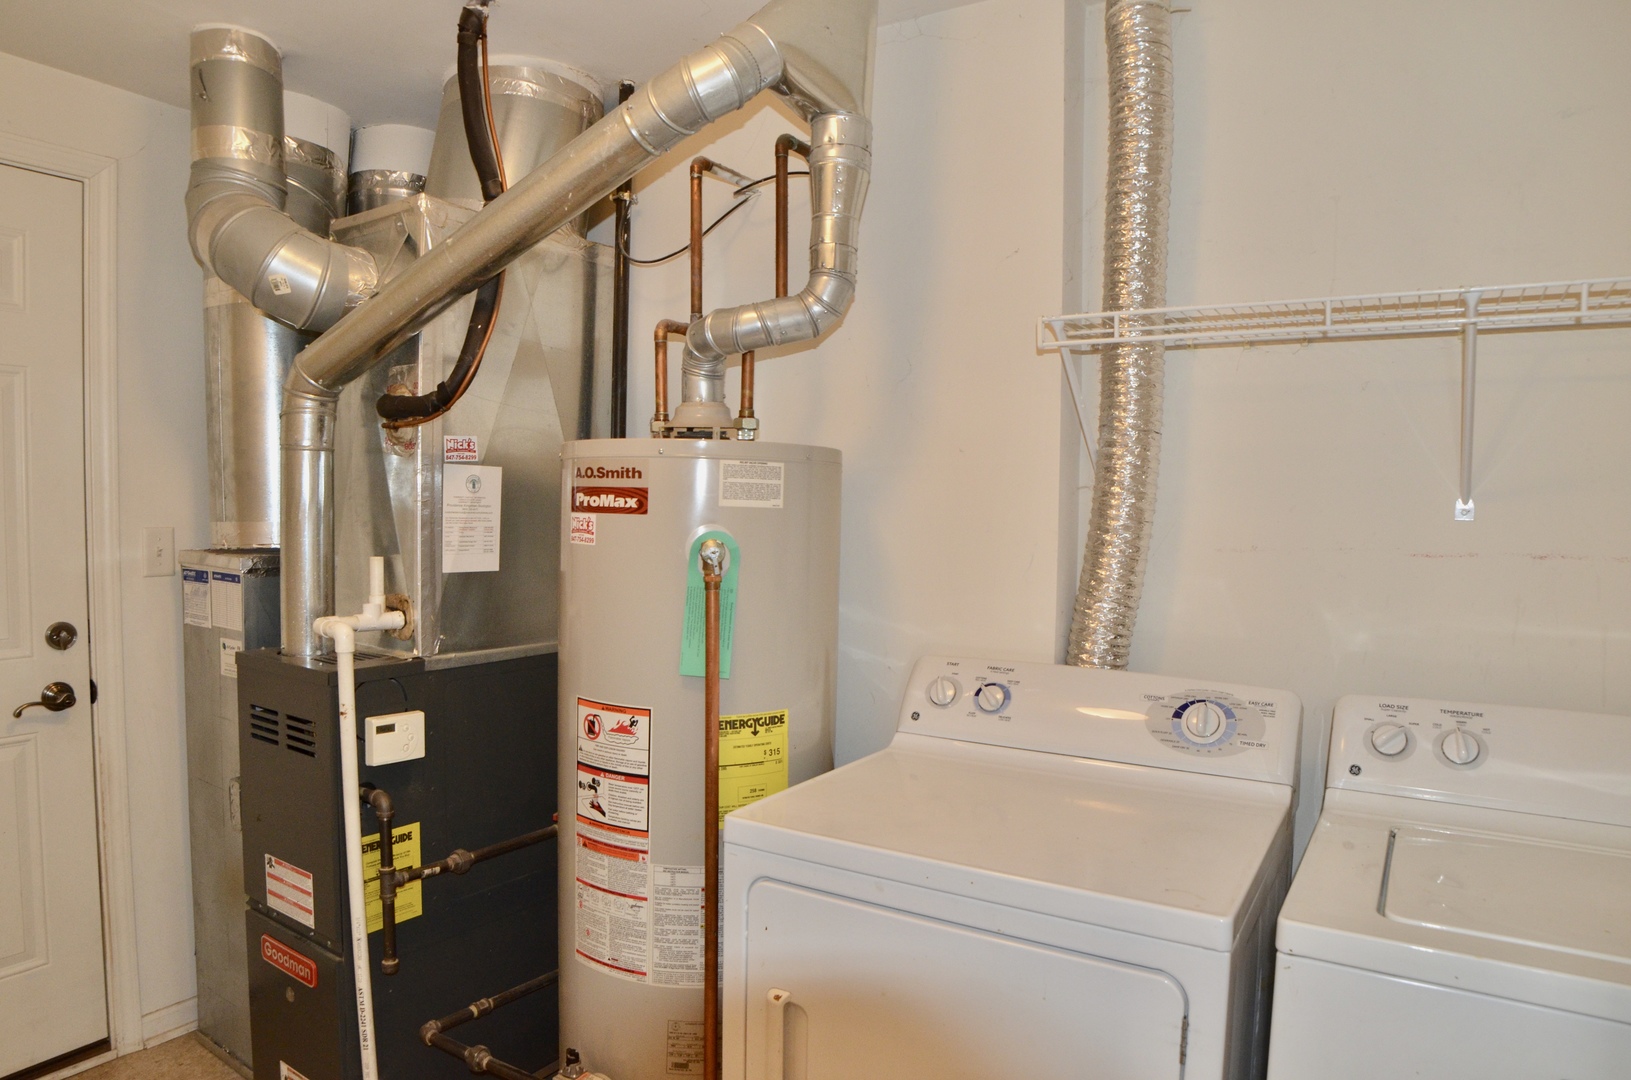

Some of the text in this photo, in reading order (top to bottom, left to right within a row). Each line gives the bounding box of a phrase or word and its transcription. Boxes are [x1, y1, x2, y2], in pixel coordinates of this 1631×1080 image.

[446, 438, 476, 450] Nick's
[576, 492, 638, 508] ProMax
[1440, 709, 1483, 718] TEMPERATURE
[719, 714, 785, 730] ENERGYGUIDE
[769, 748, 780, 756] 315
[264, 942, 310, 980] Goodman
